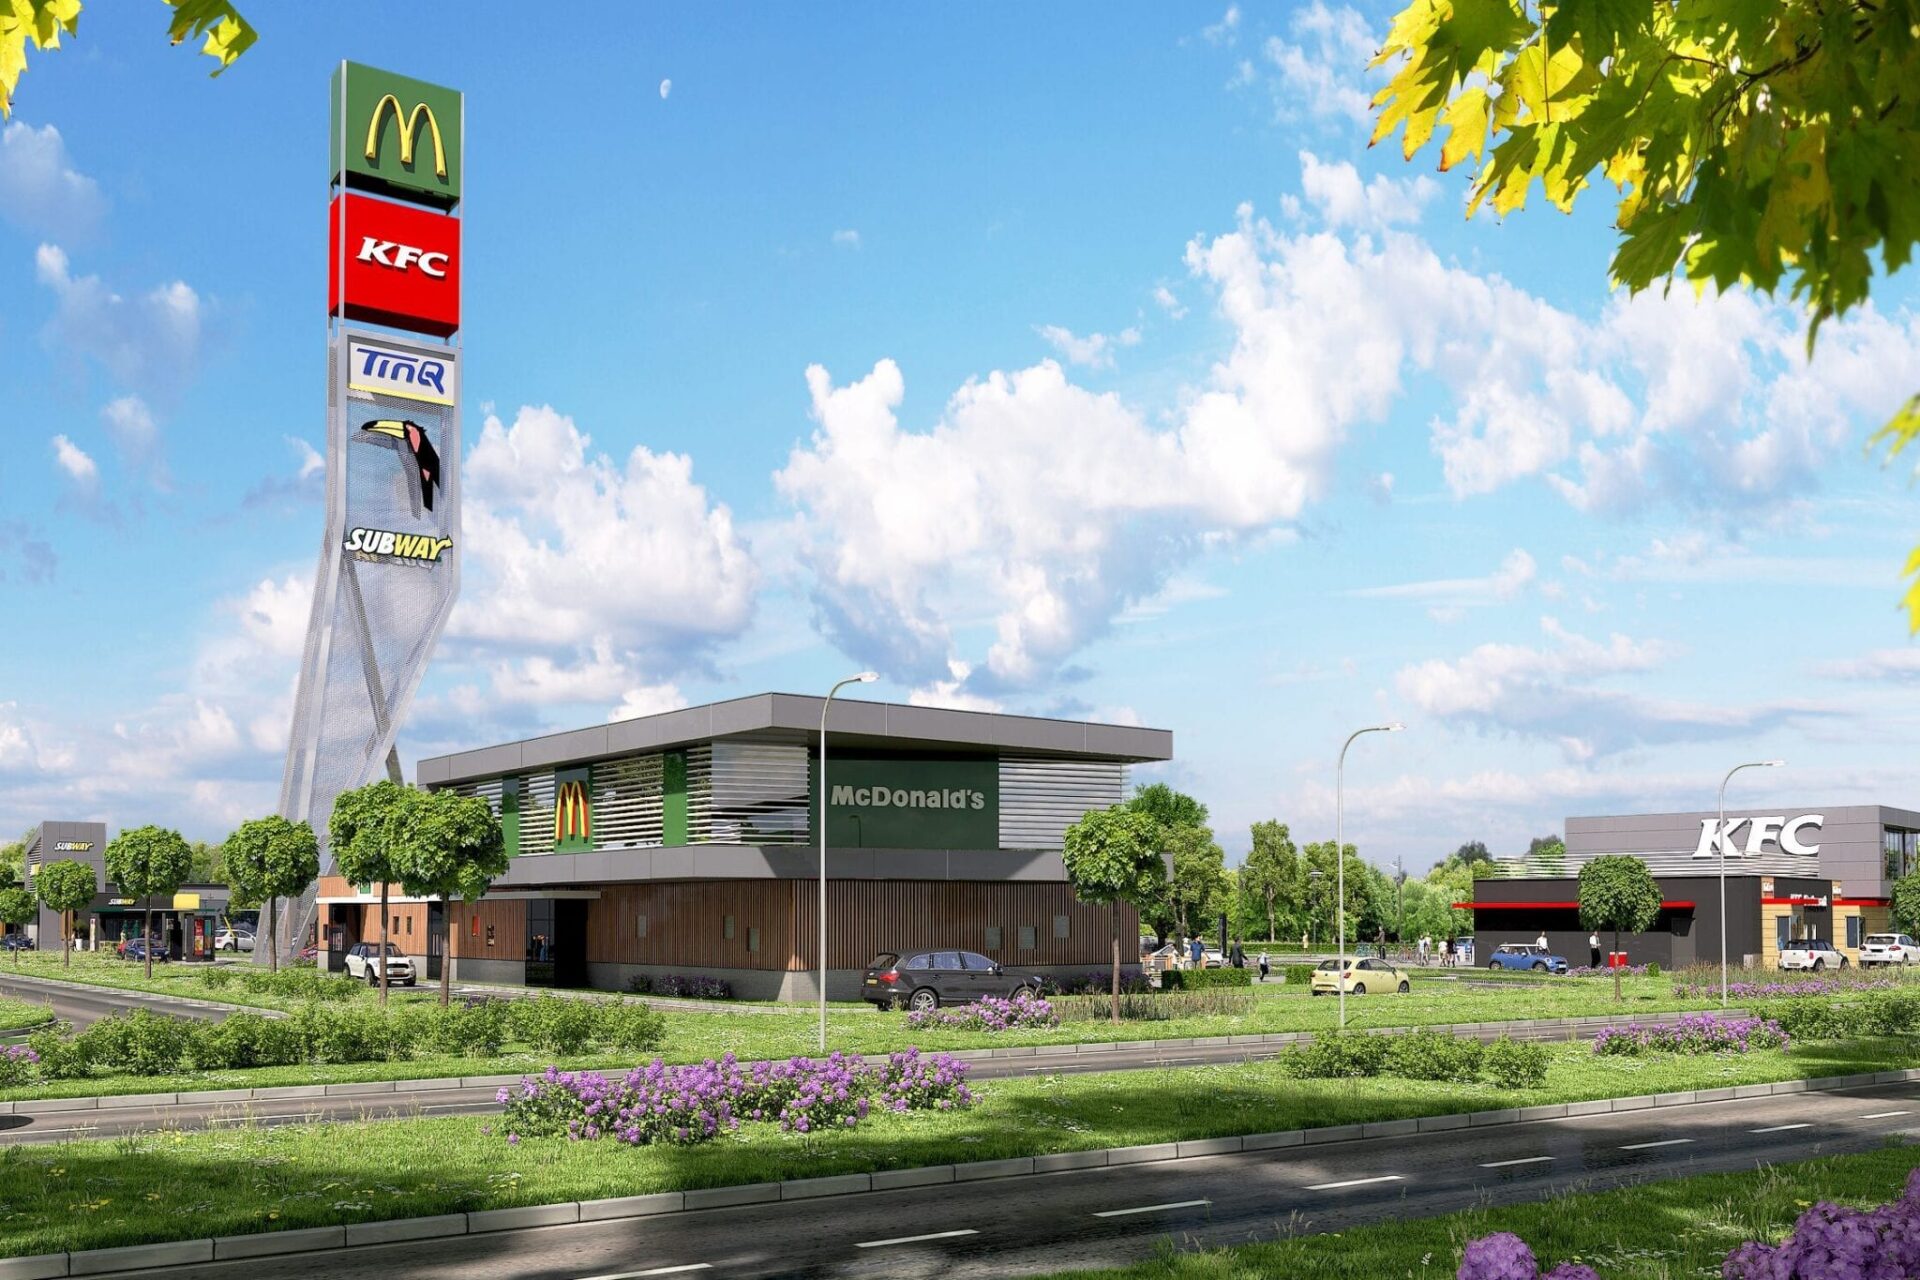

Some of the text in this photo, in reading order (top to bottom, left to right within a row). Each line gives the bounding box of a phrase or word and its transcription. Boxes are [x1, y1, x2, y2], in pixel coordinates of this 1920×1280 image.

[356, 236, 449, 277] KFC
[343, 528, 453, 561] SUBWAY
[831, 785, 985, 809] McDonald's
[54, 841, 94, 851] SUBWAY
[1692, 814, 1824, 857] KFC
